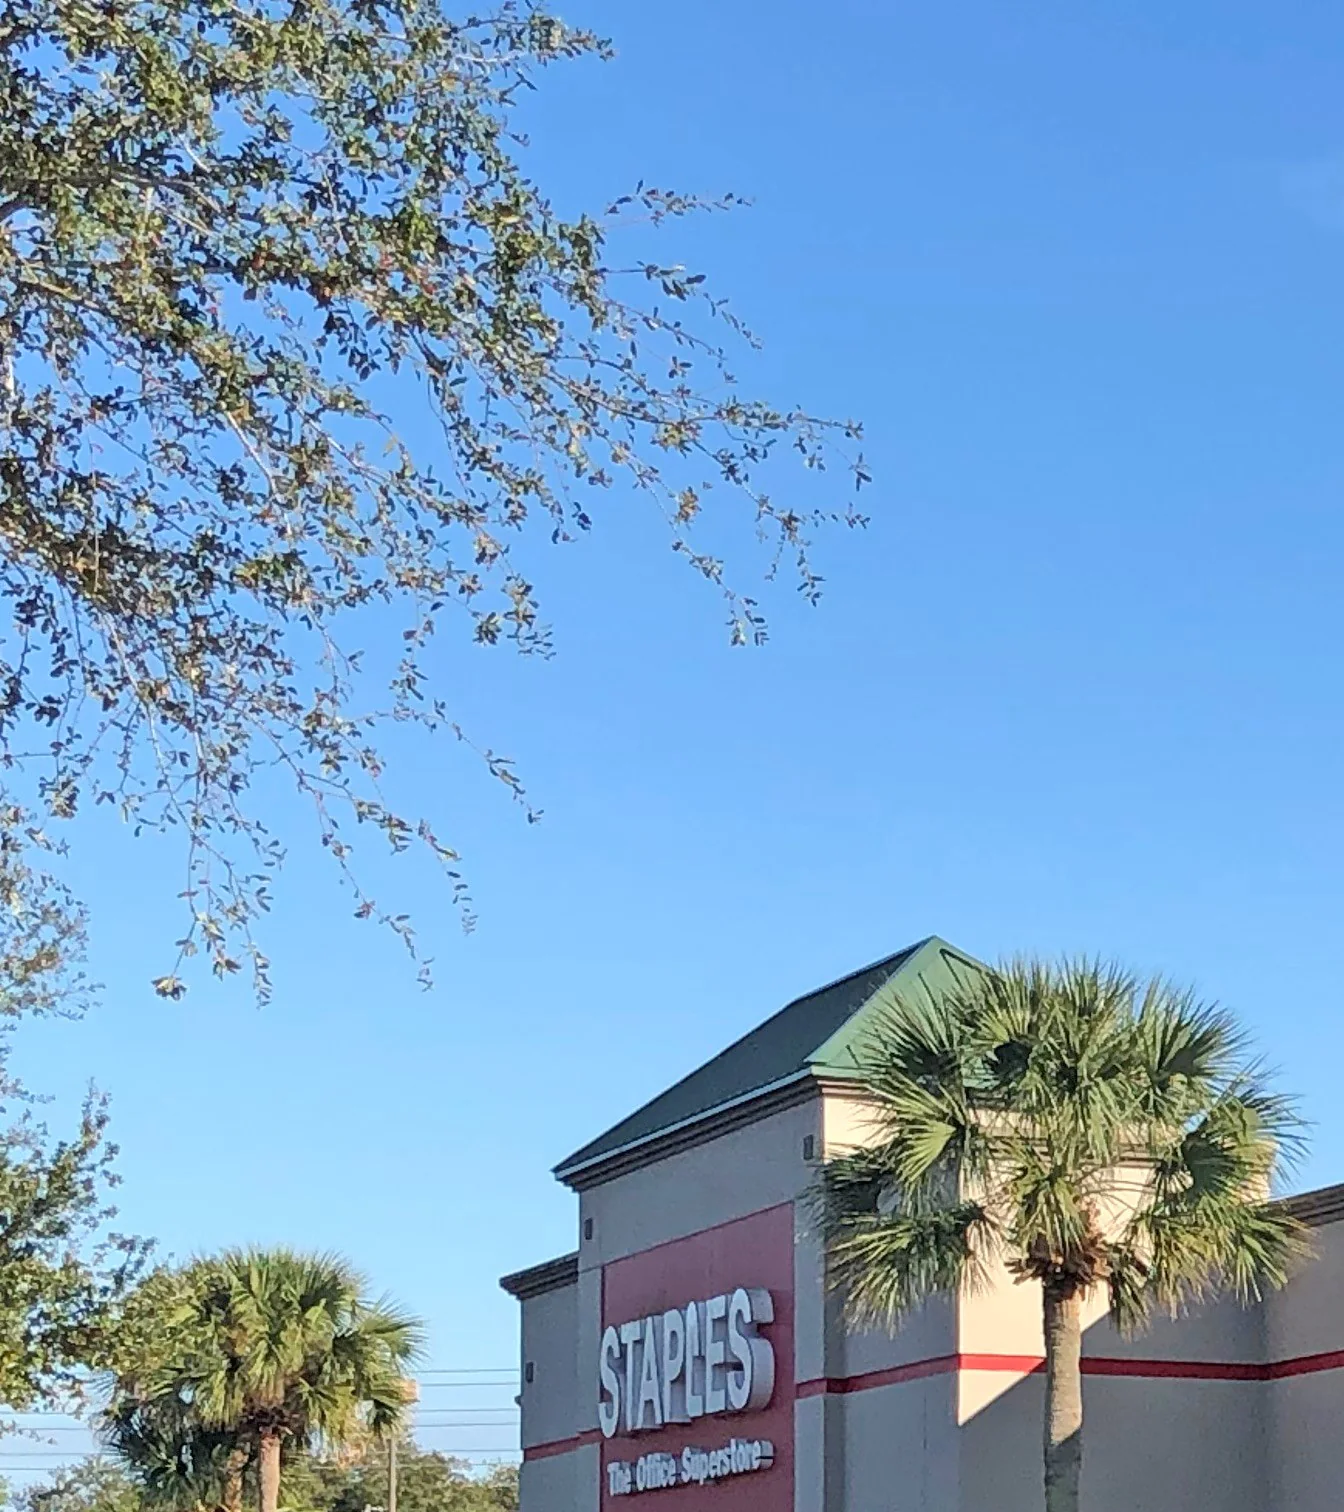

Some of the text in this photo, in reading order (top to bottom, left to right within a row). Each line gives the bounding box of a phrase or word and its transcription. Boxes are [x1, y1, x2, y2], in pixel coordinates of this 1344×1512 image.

[600, 1288, 775, 1438] STAPLES
[607, 1439, 773, 1496] The Office Superstore
